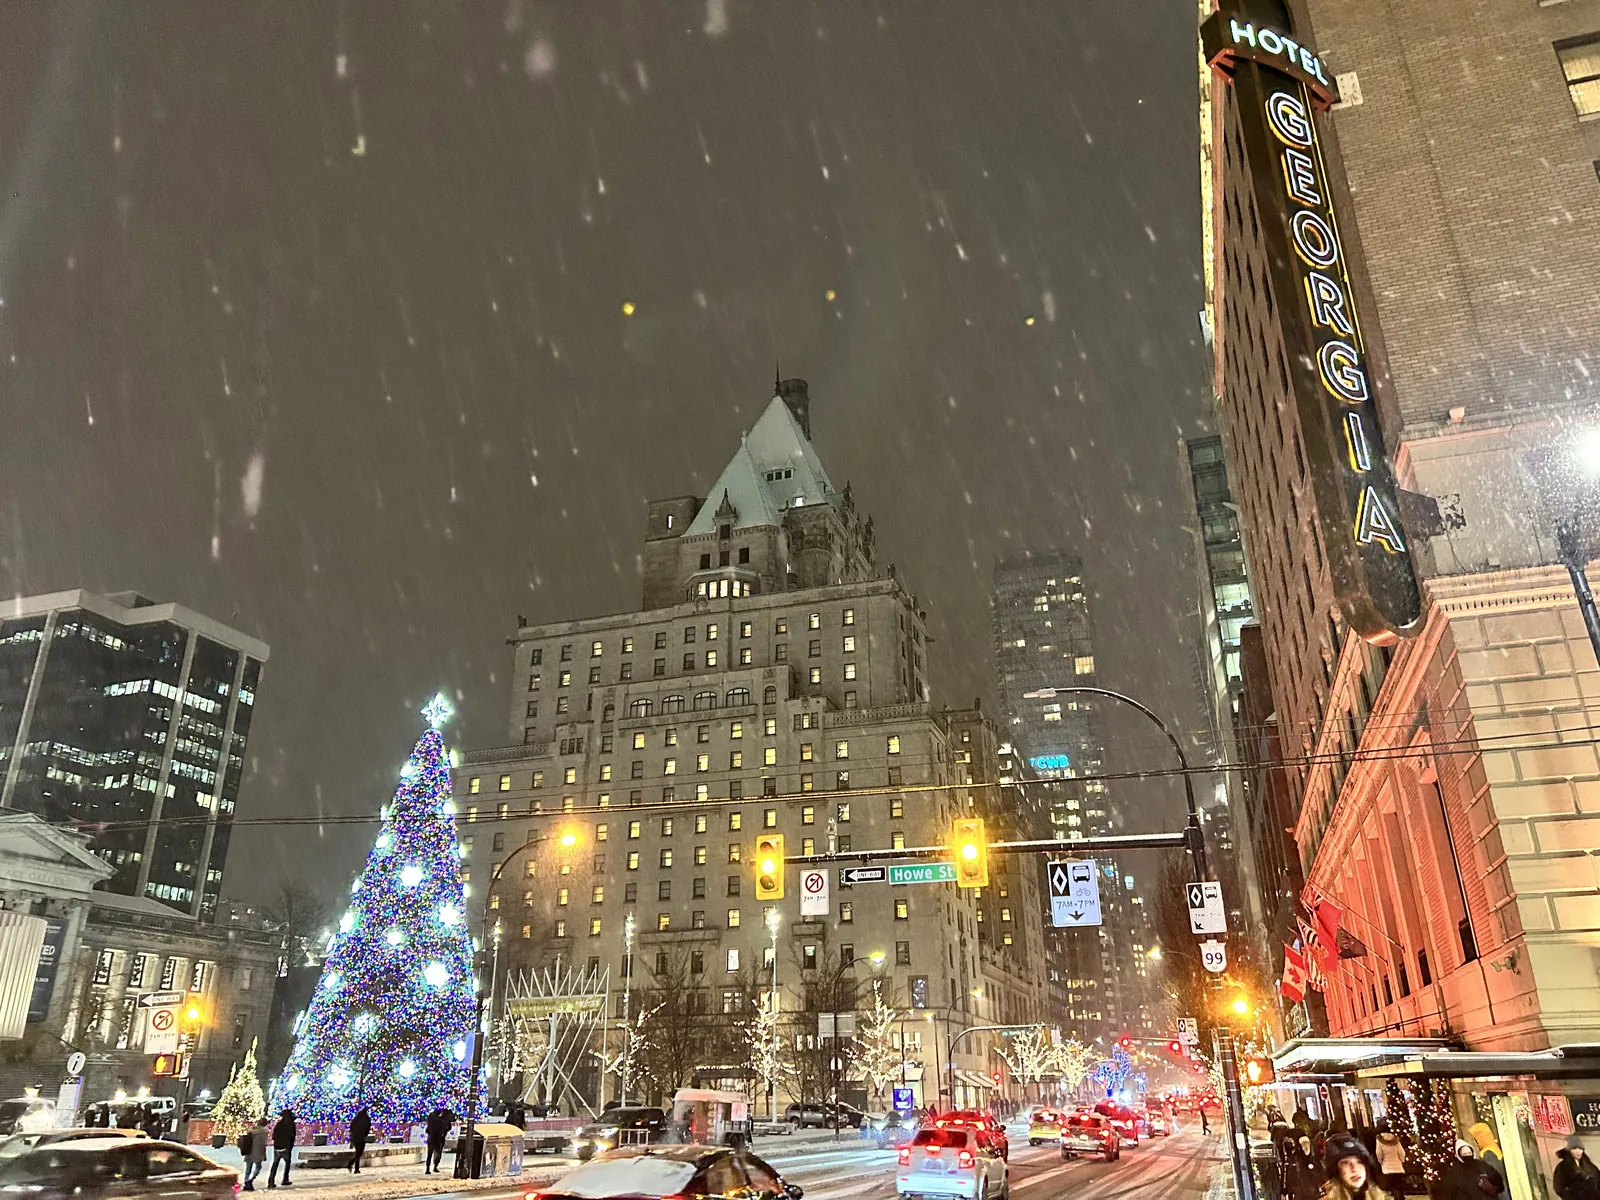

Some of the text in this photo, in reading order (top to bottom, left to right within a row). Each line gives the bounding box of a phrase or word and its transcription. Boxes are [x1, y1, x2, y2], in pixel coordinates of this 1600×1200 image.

[1230, 20, 1329, 85] HOTEL
[1266, 92, 1405, 553] GEORGIA
[1037, 755, 1069, 769] CWB
[894, 865, 953, 881] Howe St
[1205, 952, 1223, 965] 99
[1588, 1102, 1600, 1112] H
